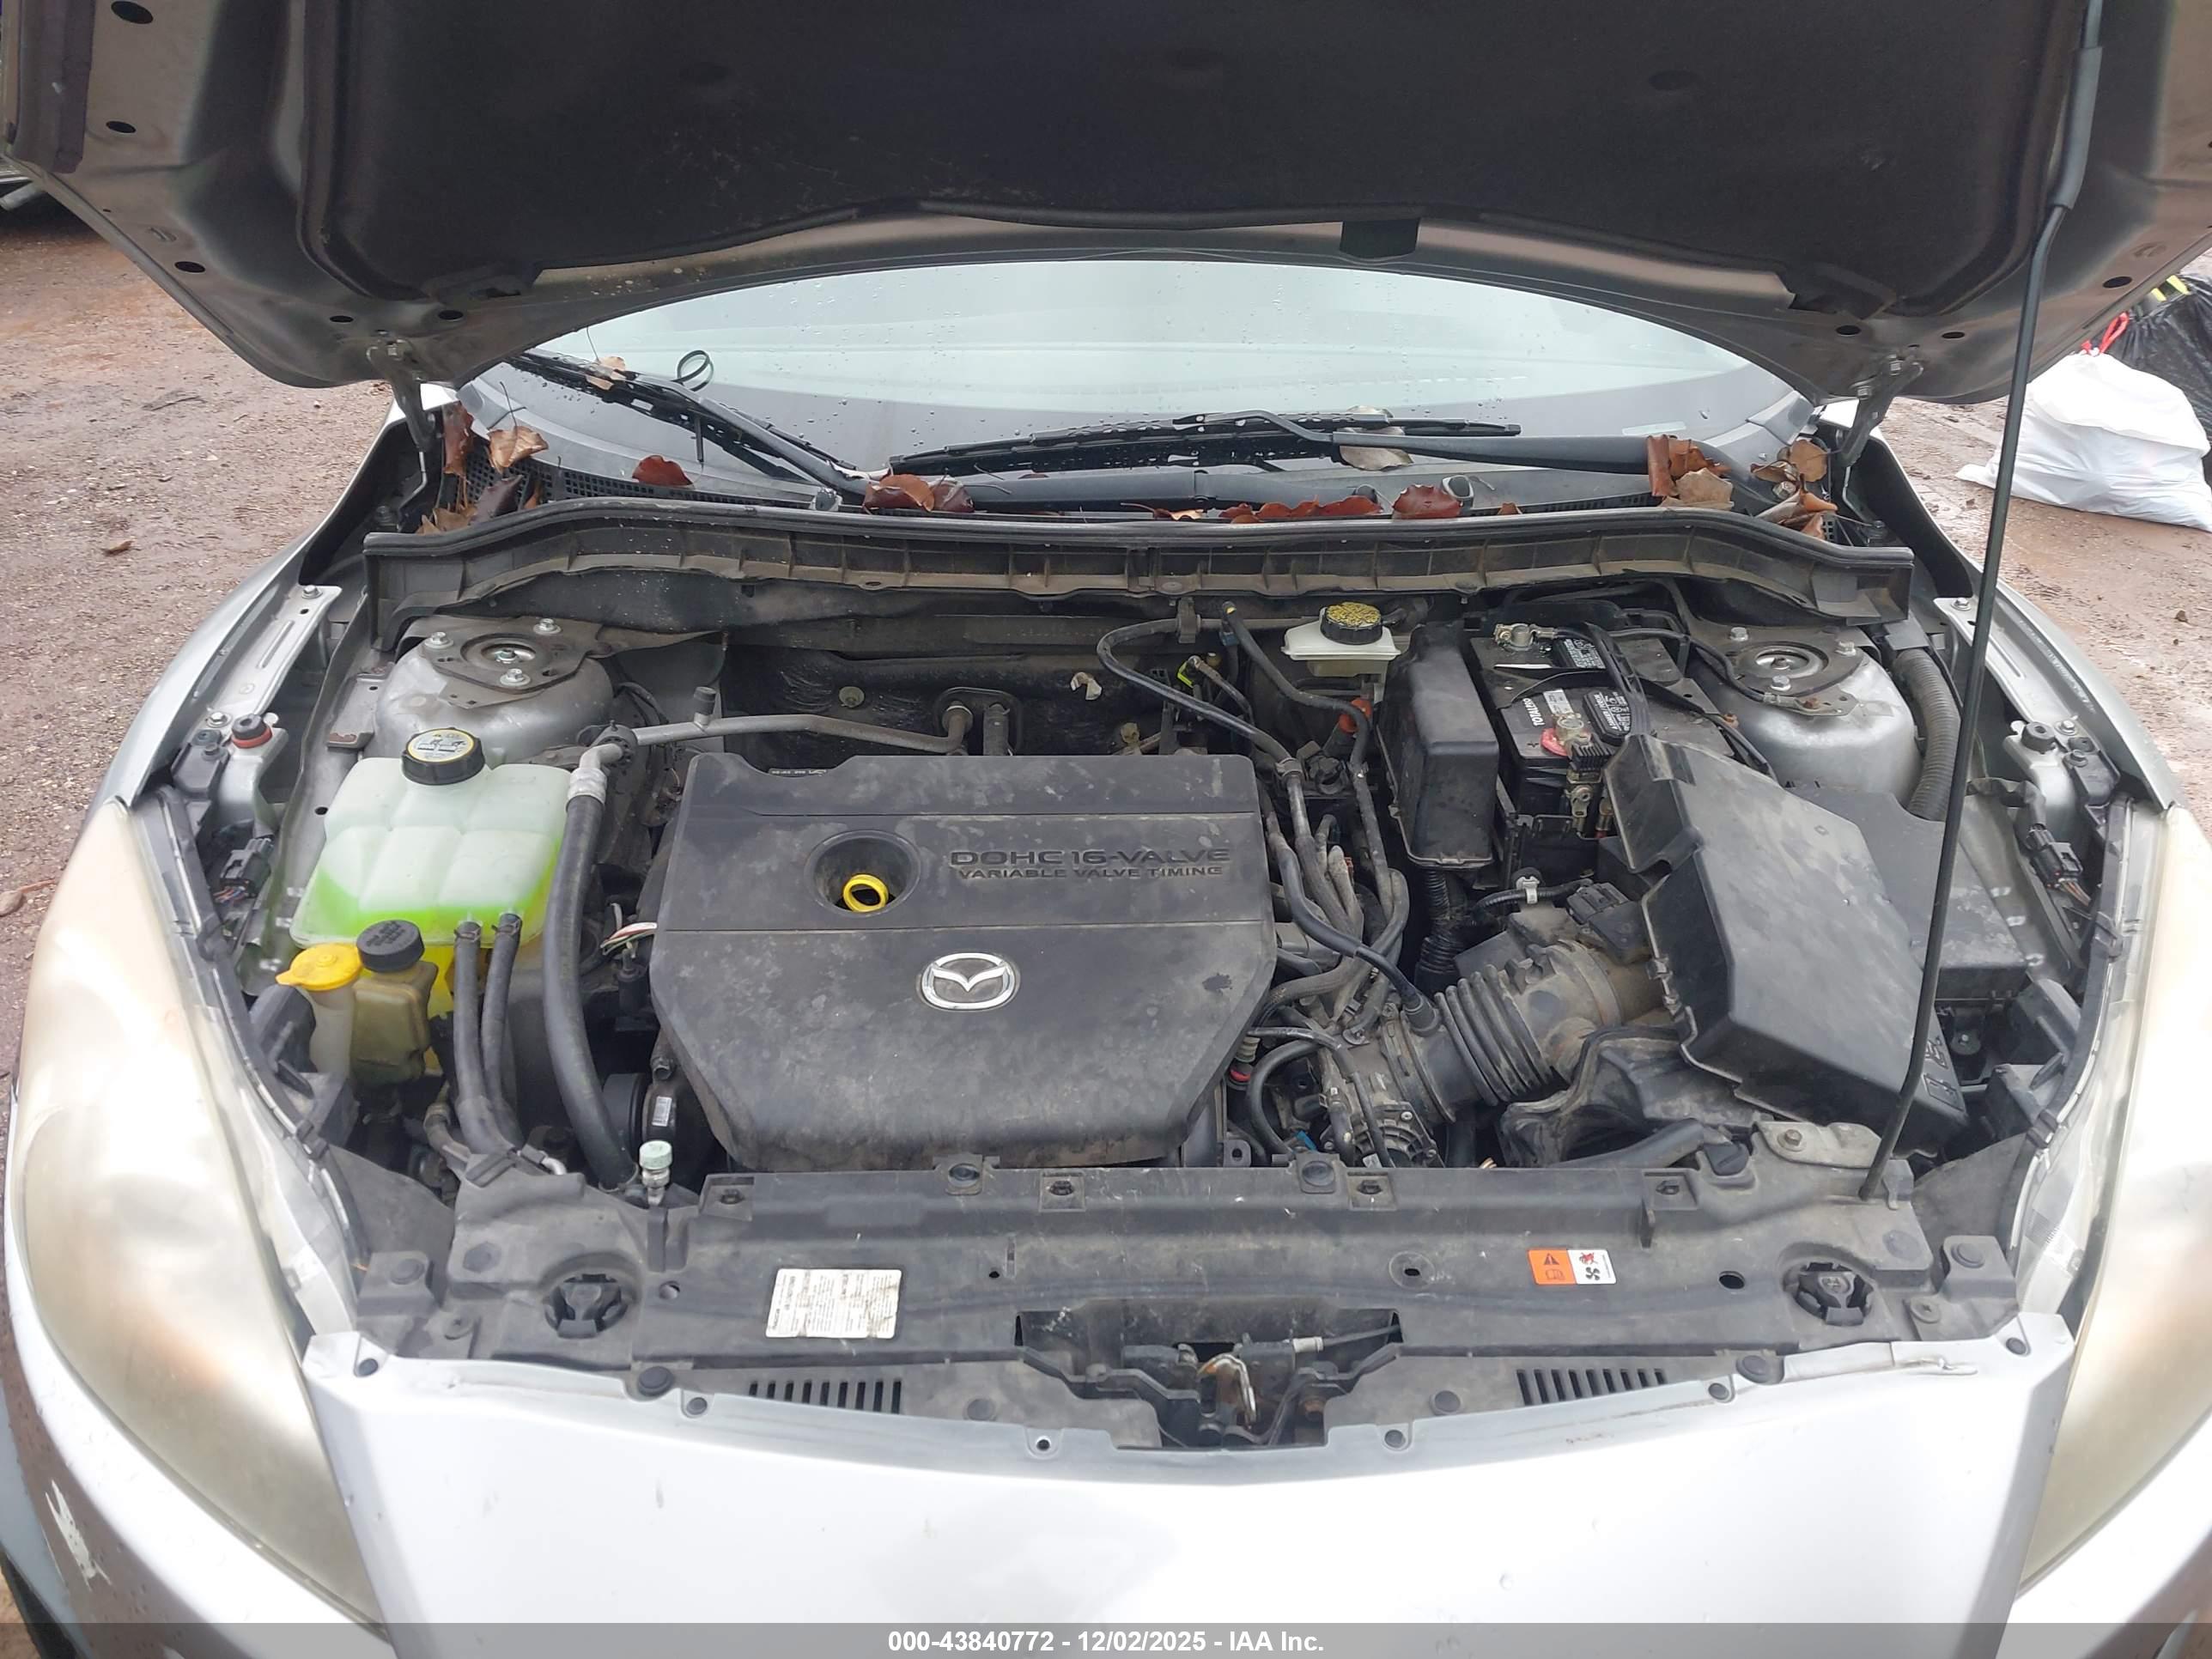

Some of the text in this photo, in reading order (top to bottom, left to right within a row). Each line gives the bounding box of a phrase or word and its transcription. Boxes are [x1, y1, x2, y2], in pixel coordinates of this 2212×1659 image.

[950, 848, 1231, 866] DOHC 16-VALVE
[958, 866, 1224, 879] VARIABLE VALVE TIMING
